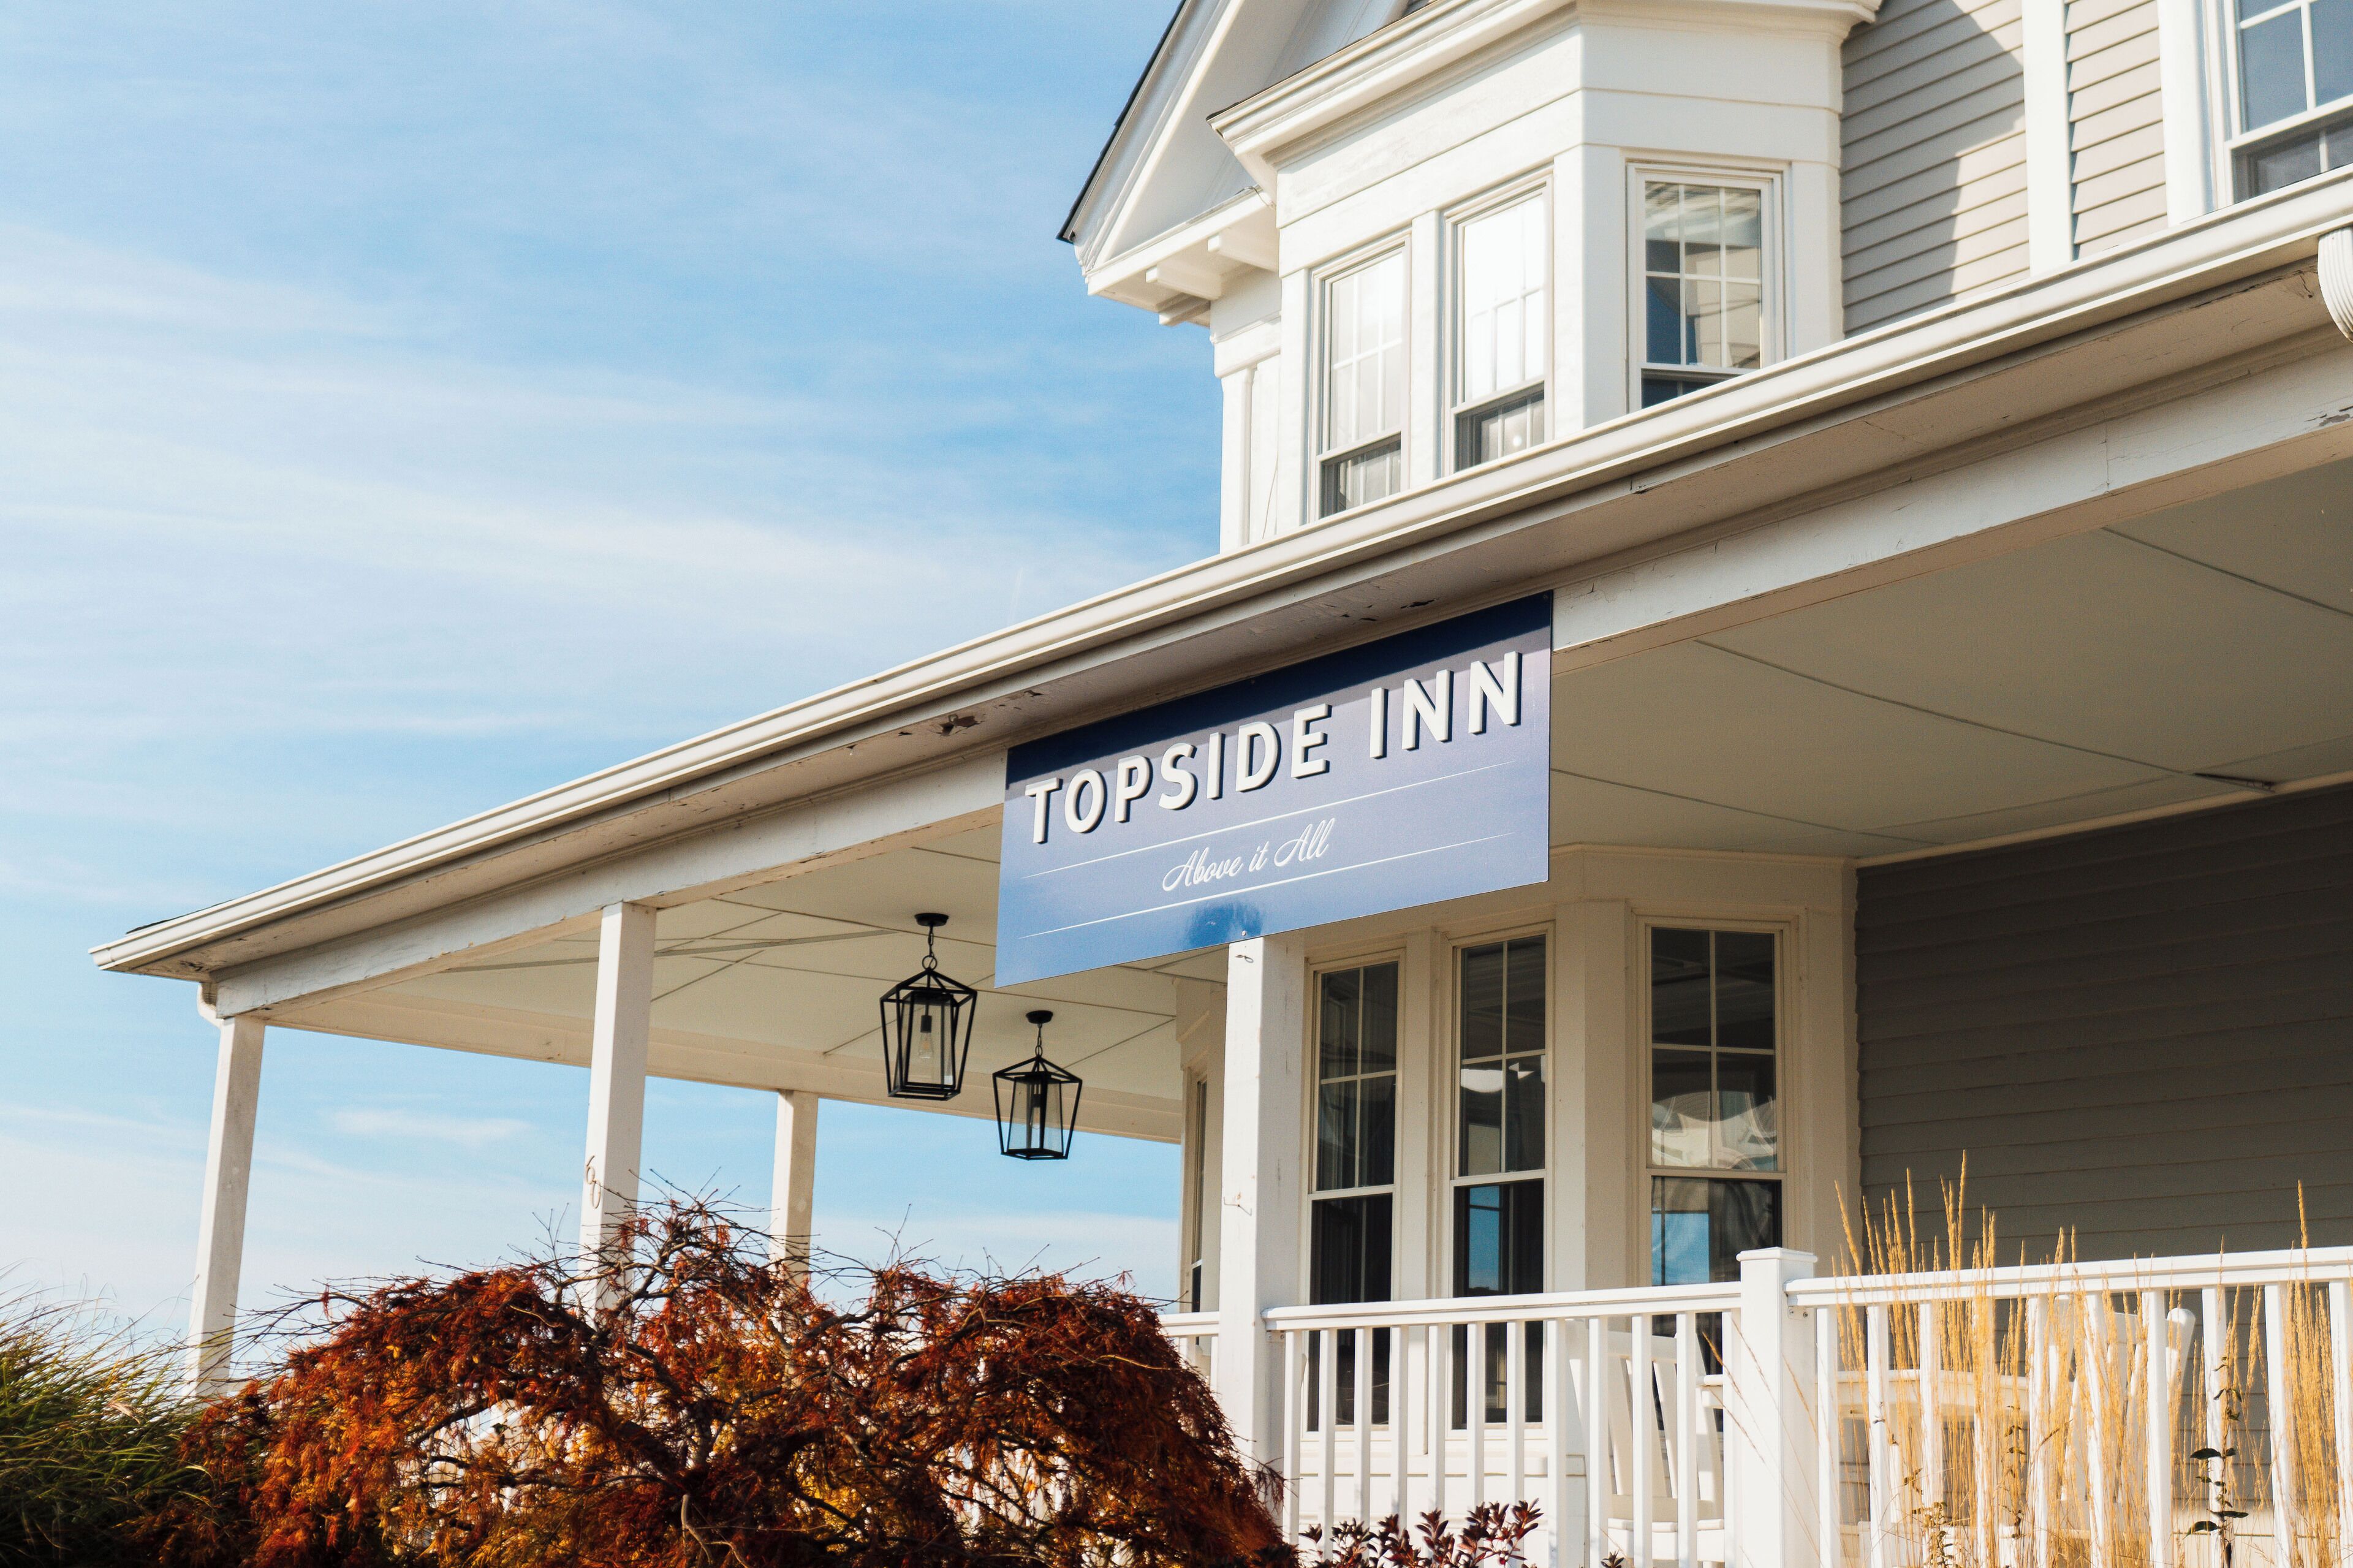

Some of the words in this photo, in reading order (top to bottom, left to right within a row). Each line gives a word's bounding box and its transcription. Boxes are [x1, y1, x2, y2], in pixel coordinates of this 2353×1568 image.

[1025, 703, 1332, 844] TOPSIDE
[1369, 651, 1522, 759] INN
[1162, 847, 1244, 891] Above
[1248, 841, 1270, 873] it
[1273, 817, 1336, 867] All
[586, 1155, 601, 1209] 60
